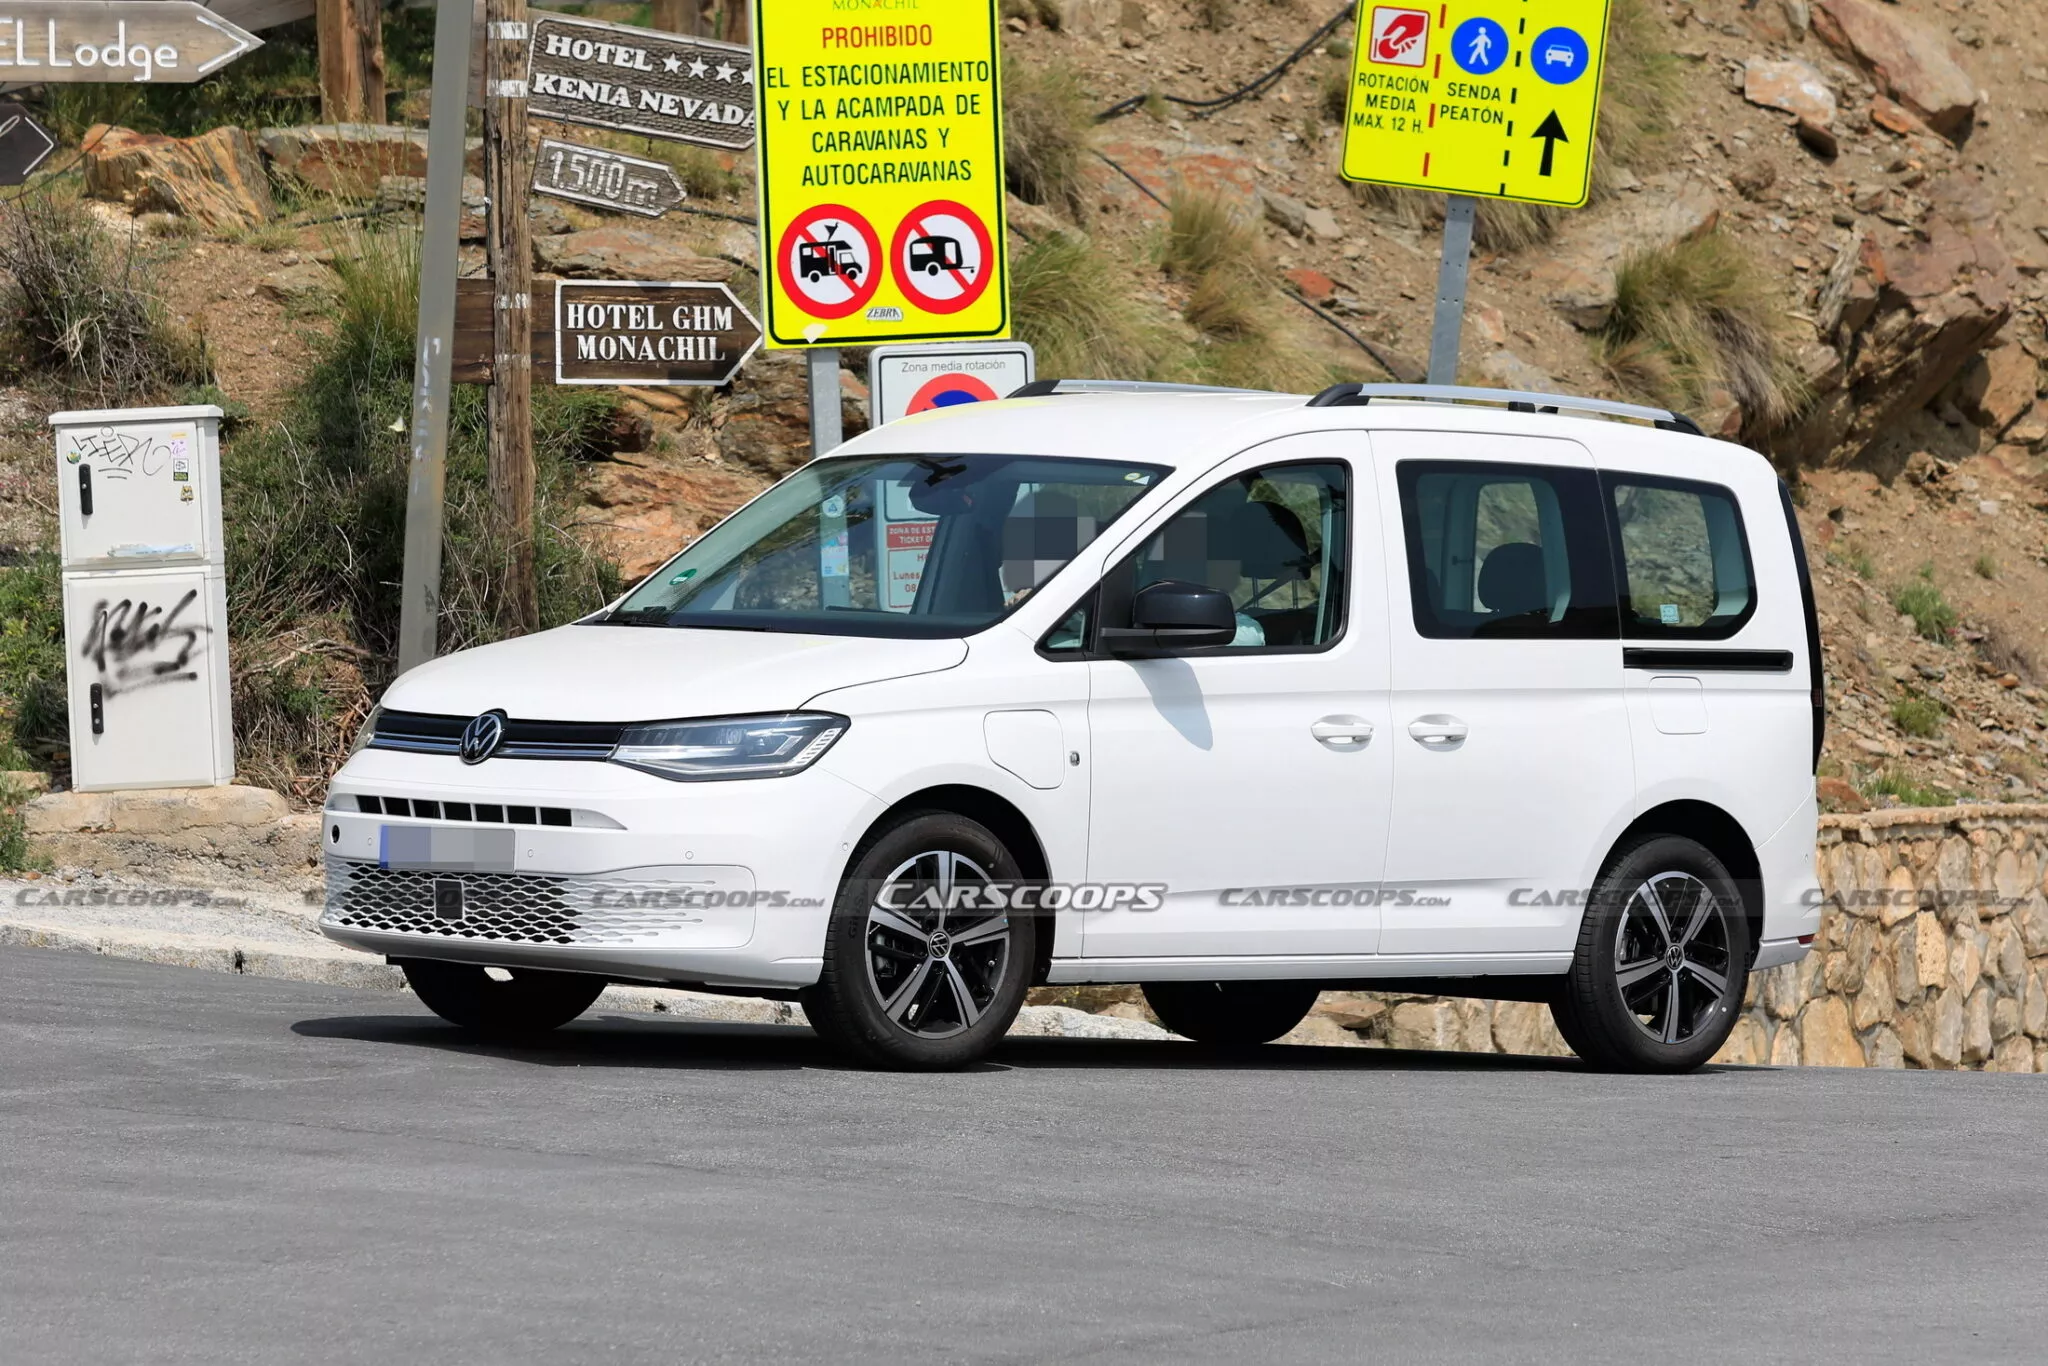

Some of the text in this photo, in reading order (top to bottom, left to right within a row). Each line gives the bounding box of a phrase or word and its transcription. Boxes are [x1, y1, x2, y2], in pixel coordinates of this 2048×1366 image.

[822, 24, 933, 49] PROHIBIDO
[49, 18, 179, 82] Lodge
[544, 34, 653, 72] HOTEL
[767, 61, 989, 89] EL ESTACIONAMIENTO
[1358, 72, 1430, 94] ROTACIÓN
[532, 73, 632, 108] KENIA
[1365, 94, 1417, 112] MEDIA
[1447, 82, 1501, 102] SENDA
[778, 94, 981, 121] Y LA ACAMPADA DE
[1440, 104, 1504, 125] PEATÓN
[1391, 117, 1406, 132] 12
[1412, 119, 1424, 134] H.
[812, 128, 949, 153] CARAVANAS Y
[802, 159, 972, 187] AUTOCARAVANAS
[567, 303, 734, 331] HOTEL GHM
[866, 307, 900, 318] ZEBRA
[576, 334, 726, 361] MONACHIL
[901, 358, 1006, 373] Zona media rotación
